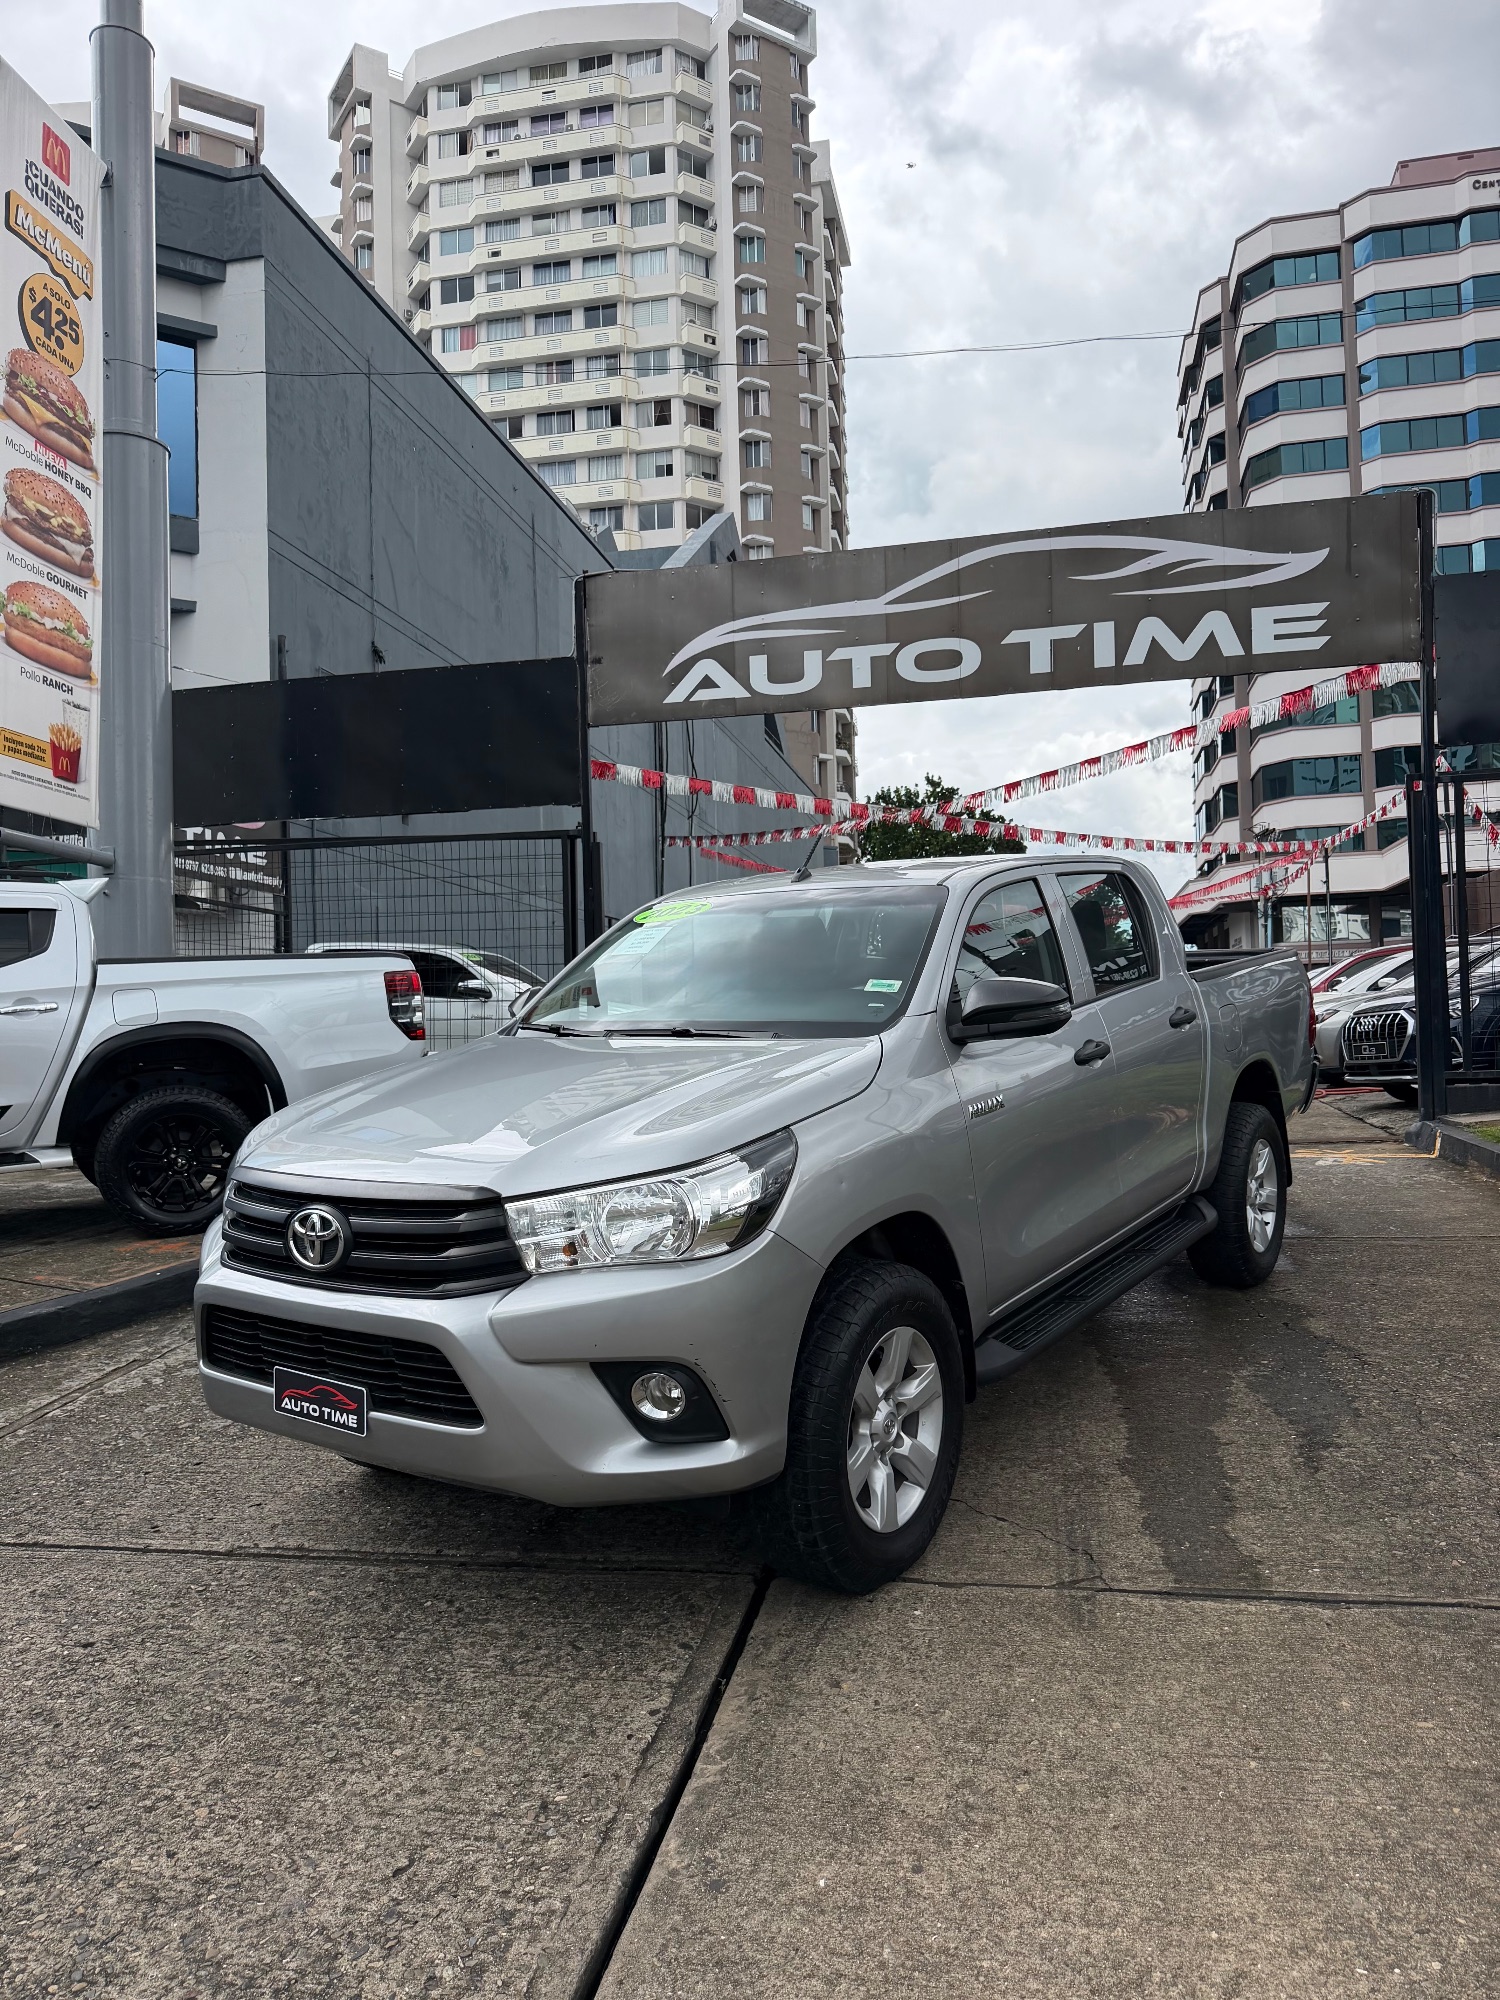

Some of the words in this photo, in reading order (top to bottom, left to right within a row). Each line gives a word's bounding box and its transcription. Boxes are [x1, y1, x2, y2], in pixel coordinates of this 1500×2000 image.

[25, 158, 84, 221] ¡CUANDO
[25, 175, 84, 239] QUIERAS!
[15, 204, 91, 289] McMenú
[43, 282, 49, 292] A
[49, 288, 71, 310] SOLO
[36, 336, 58, 359] CADA
[59, 352, 75, 371] UNA
[5, 436, 44, 466] McDoble
[45, 460, 74, 485] HONEY
[75, 479, 92, 499] BBQ
[36, 442, 66, 469] NUEVA
[6, 551, 45, 578] McDoble
[46, 571, 89, 600] GOURMET
[661, 637, 984, 704] AUTO
[1001, 601, 1332, 675] TIME
[20, 666, 41, 683] Pollo
[42, 675, 74, 696] RANCH
[1361, 1045, 1376, 1055] Q3
[281, 1397, 320, 1417] AUTO
[321, 1406, 358, 1428] TIME
